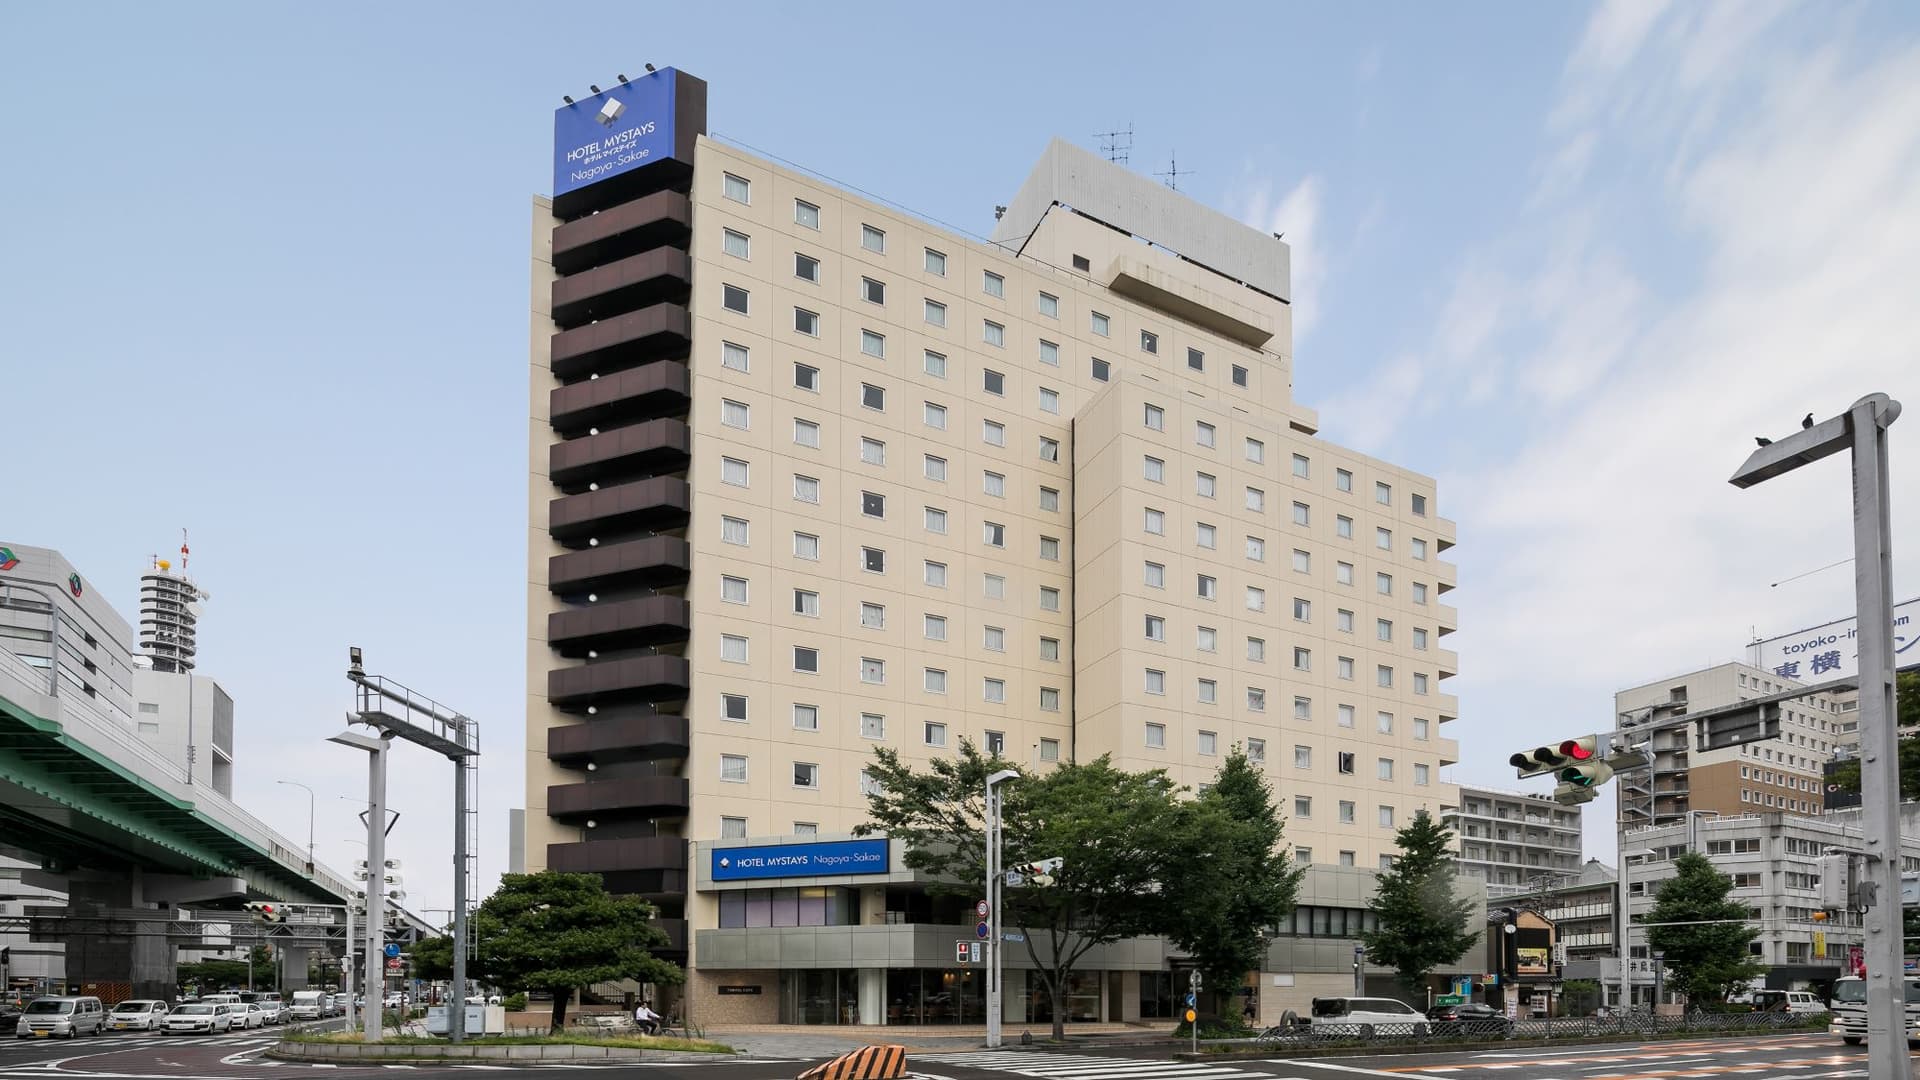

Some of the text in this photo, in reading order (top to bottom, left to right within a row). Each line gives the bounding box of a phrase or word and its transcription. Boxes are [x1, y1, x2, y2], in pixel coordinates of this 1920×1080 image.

[567, 121, 655, 162] HOTEL MYSTAYS
[571, 148, 650, 183] Nagoya-Sakae
[1773, 635, 1920, 679] 東横ン
[737, 852, 881, 868] HOTEL MYSTAYS Nagoya-Sakae
